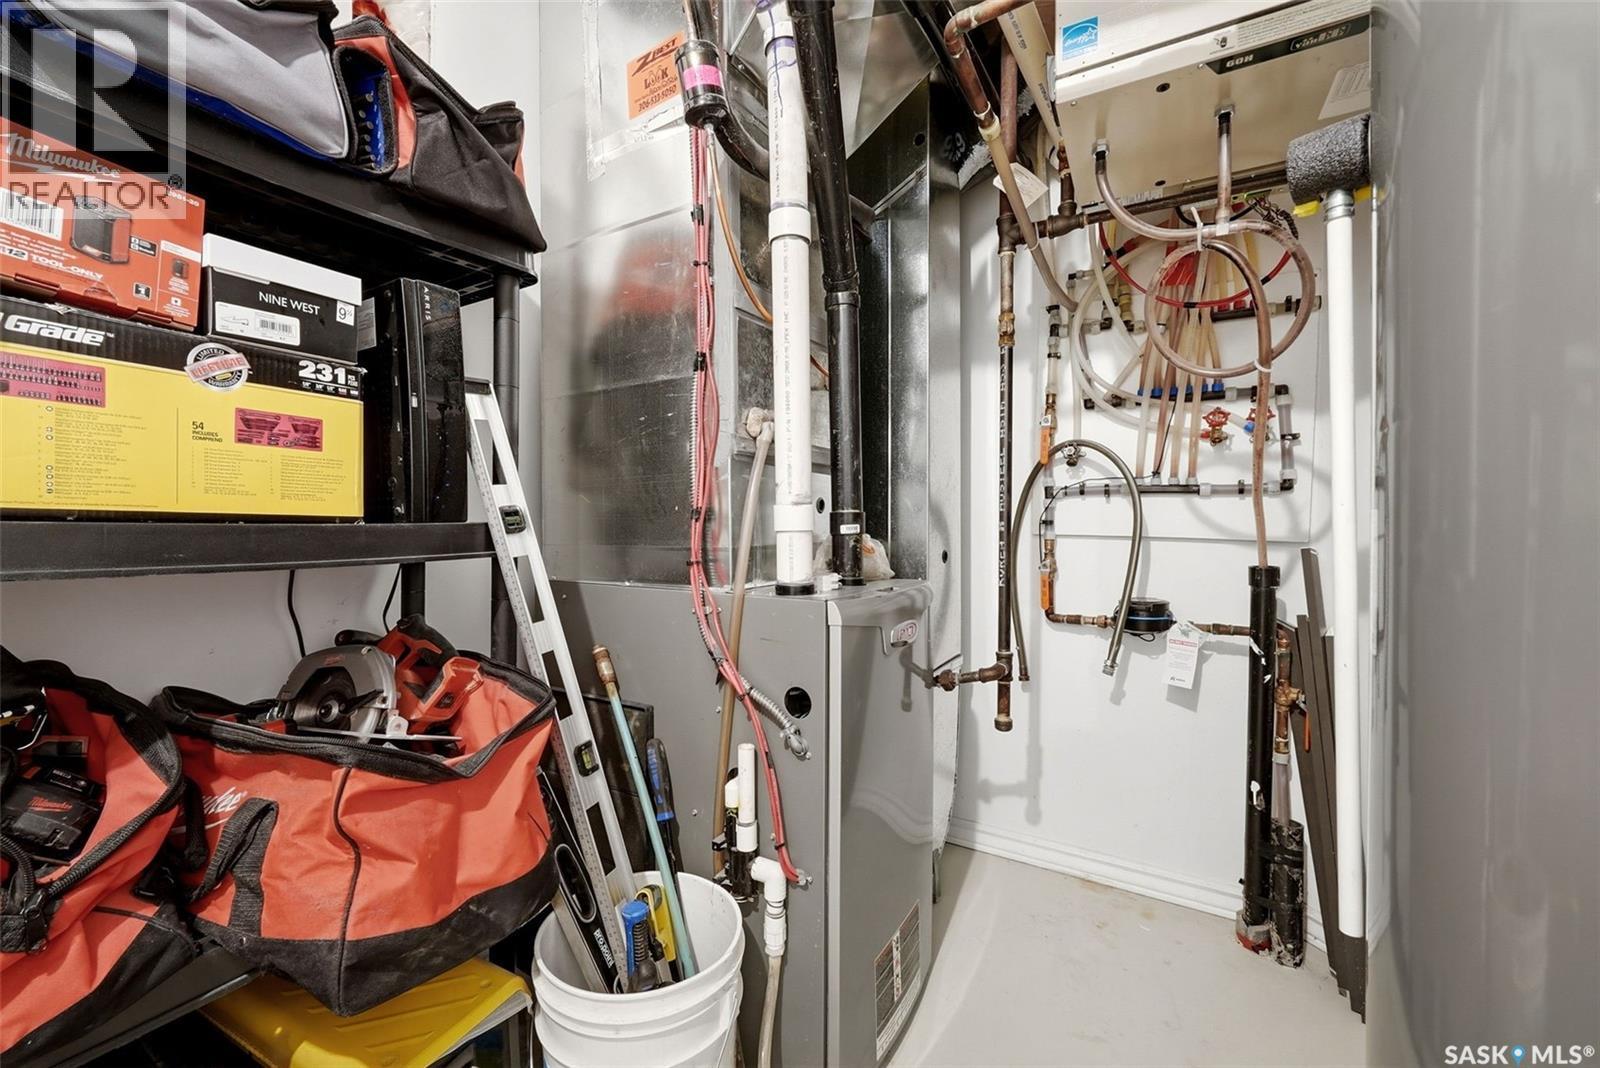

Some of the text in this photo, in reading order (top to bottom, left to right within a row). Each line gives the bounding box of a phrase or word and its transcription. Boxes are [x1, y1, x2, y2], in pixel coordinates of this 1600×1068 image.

[259, 291, 320, 316] NINE WEST
[298, 360, 346, 385] 231
[192, 421, 205, 430] 54
